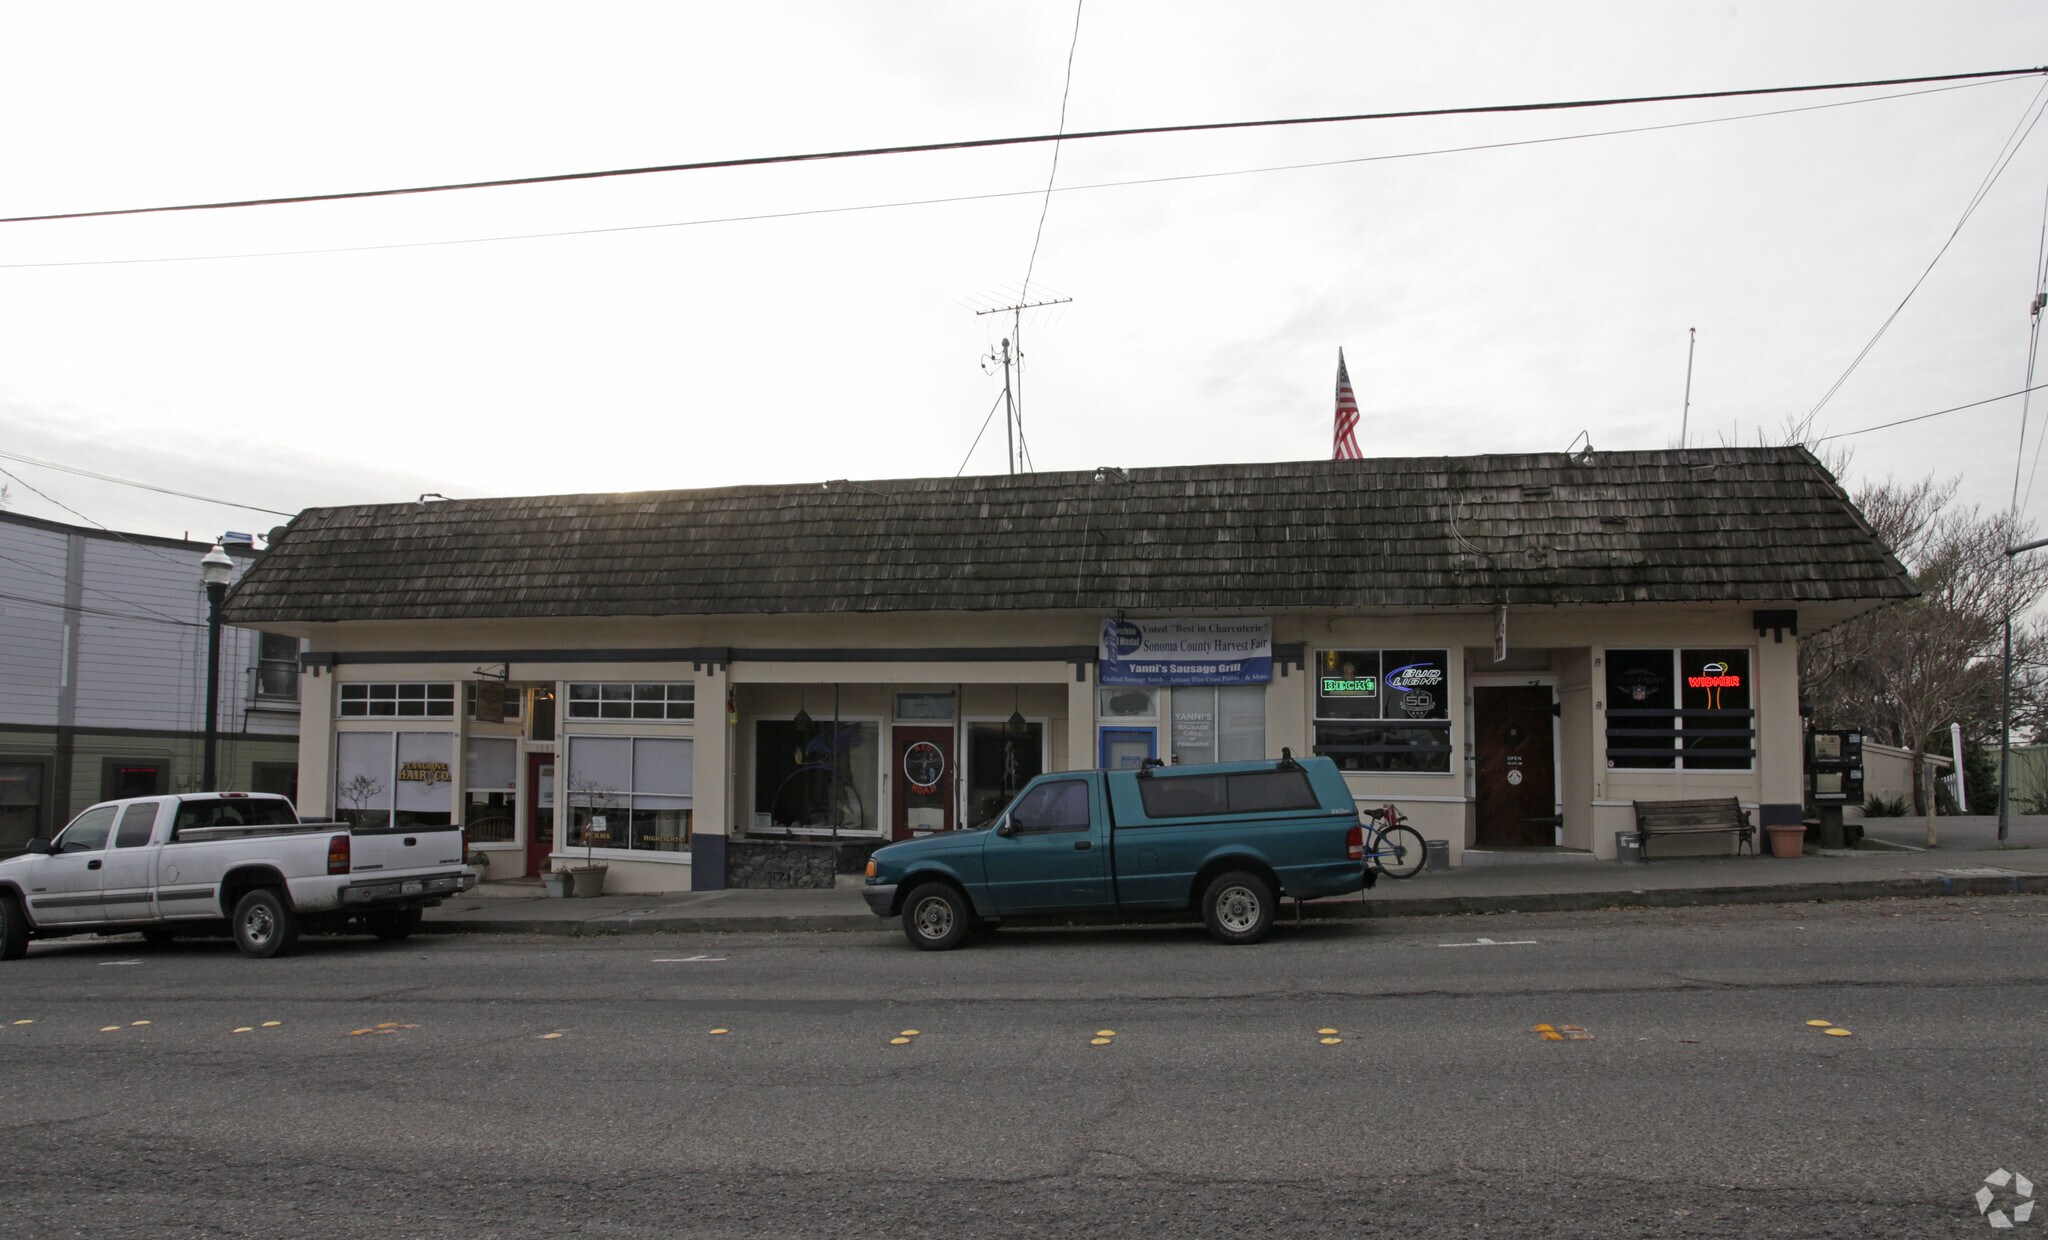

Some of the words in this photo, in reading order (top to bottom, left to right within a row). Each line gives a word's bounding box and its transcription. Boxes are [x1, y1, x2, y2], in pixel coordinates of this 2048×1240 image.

[1142, 624, 1167, 634] Voted
[1197, 624, 1206, 633] in
[1120, 637, 1139, 646] Medal
[1143, 640, 1178, 652] Sonoma
[1180, 640, 1211, 654] County
[1214, 639, 1248, 652] Harvest
[1250, 637, 1267, 650] Fair
[1129, 664, 1168, 673] Yanni's
[1169, 664, 1216, 674] Sausage
[1218, 663, 1241, 673] Grill
[1402, 668, 1440, 678] BUD
[1392, 677, 1442, 686] LIGHT
[1688, 676, 1740, 688] WIDMER
[1406, 696, 1430, 706] 50
[1175, 713, 1212, 721] YANNI'S
[399, 770, 427, 781] HAIR
[585, 832, 610, 840] PERMS
[643, 834, 683, 843] HIGHLIGHTS
